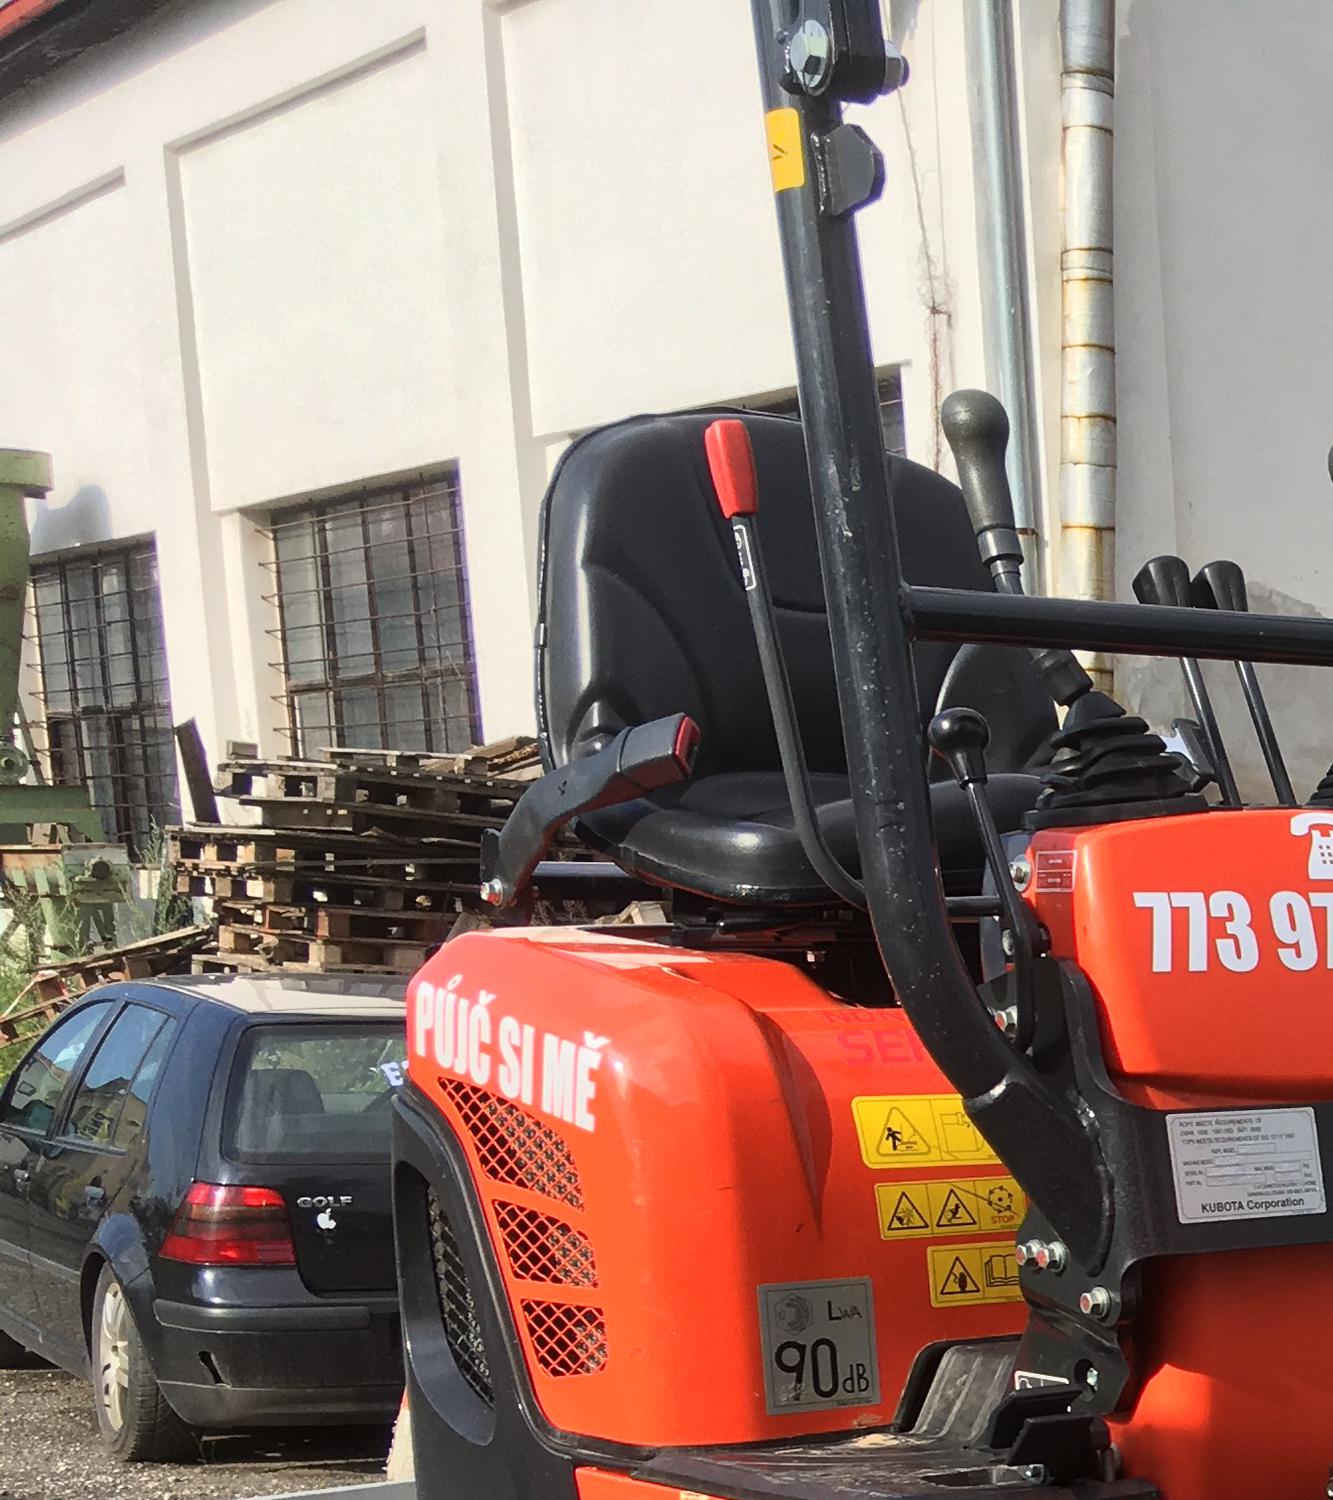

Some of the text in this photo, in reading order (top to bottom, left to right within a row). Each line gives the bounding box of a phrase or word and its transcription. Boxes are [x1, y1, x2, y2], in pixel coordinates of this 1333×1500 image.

[1134, 891, 1259, 973] 773
[416, 974, 609, 1131] PŮJČ SI MĚ
[380, 1060, 410, 1086] E
[297, 1195, 352, 1208] GOLF
[1201, 1197, 1305, 1213] KUBOTA Corporation
[991, 1214, 1015, 1224] STOP
[774, 1338, 870, 1401] 90 dB
